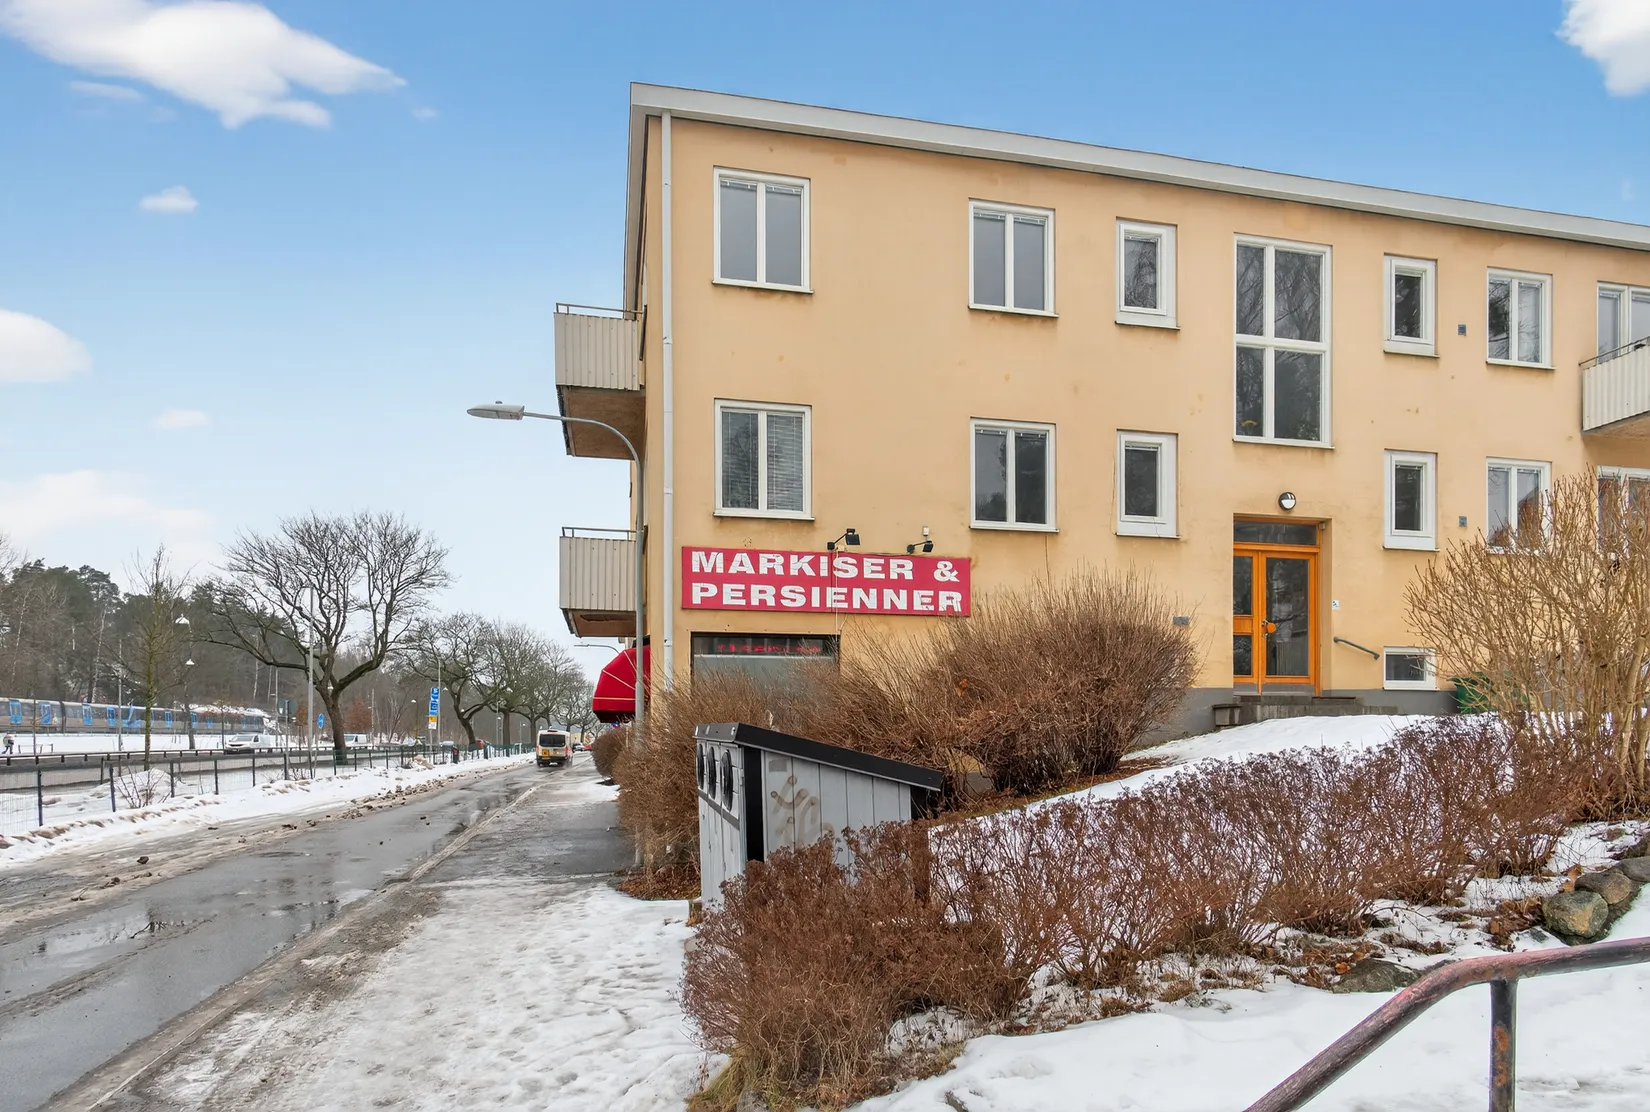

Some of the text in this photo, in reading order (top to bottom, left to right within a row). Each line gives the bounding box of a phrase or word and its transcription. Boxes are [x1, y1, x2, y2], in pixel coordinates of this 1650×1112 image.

[691, 551, 960, 583] MARKISER &
[692, 583, 962, 612] PERSIENNER
